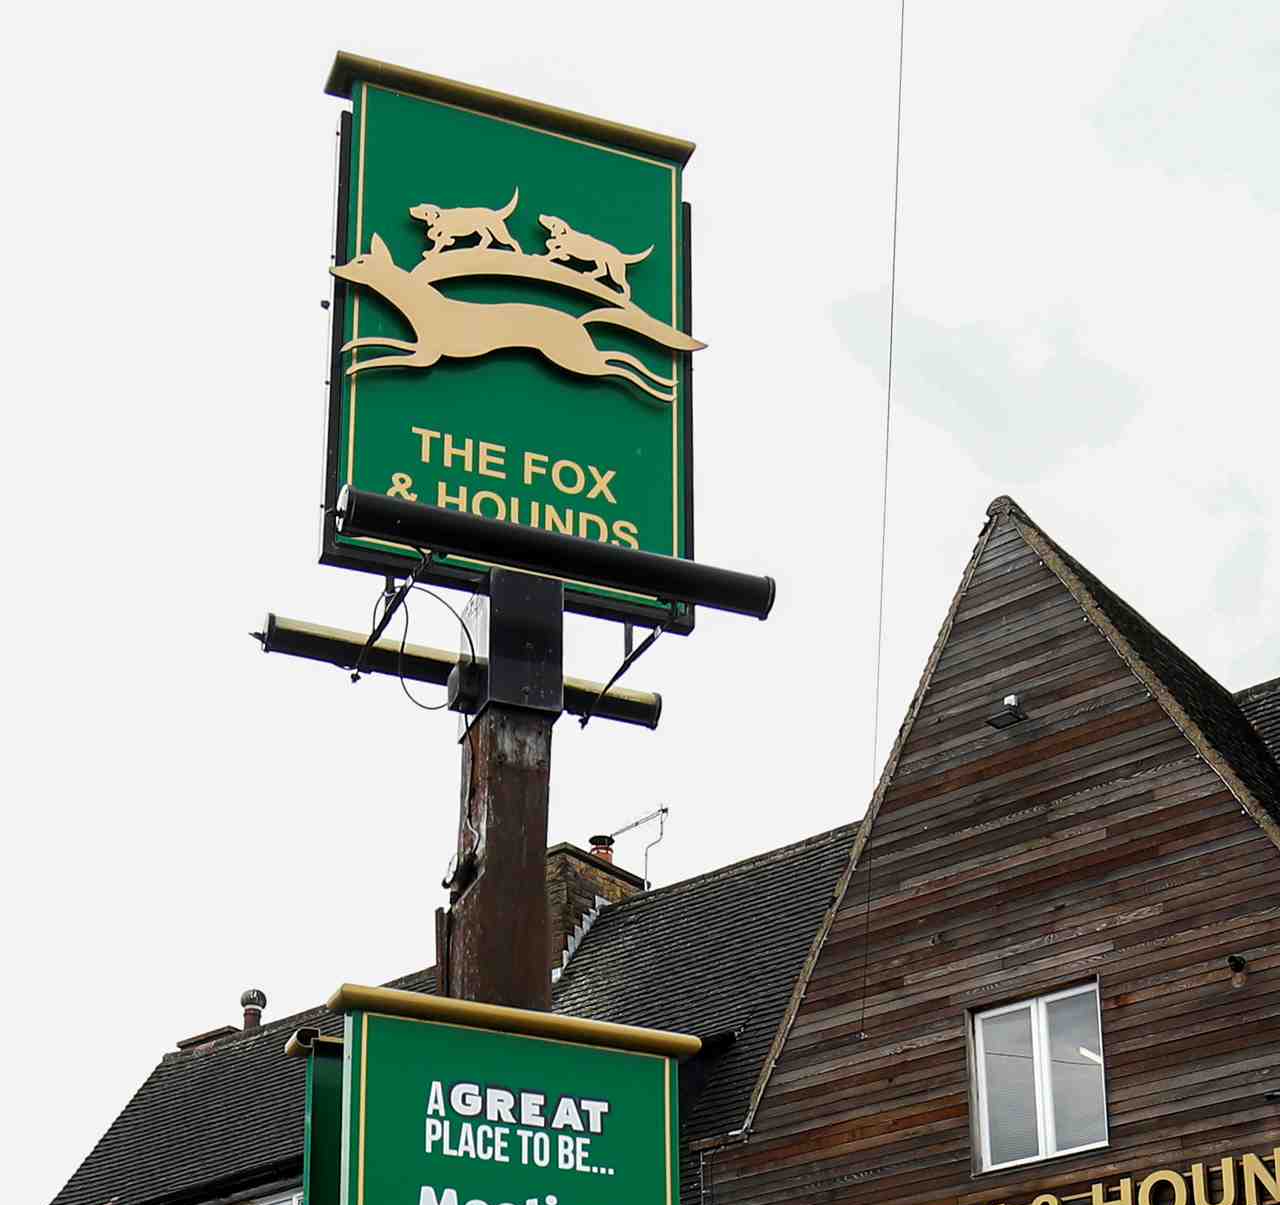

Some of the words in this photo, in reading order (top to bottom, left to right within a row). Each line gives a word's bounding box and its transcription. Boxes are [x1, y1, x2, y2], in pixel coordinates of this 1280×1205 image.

[411, 426, 507, 480] THE
[523, 450, 618, 504] FOX
[386, 472, 418, 502] &
[437, 481, 640, 550] HOUNDS
[427, 1080, 446, 1117] A
[450, 1083, 610, 1134] GREAT
[425, 1117, 510, 1163] PLACE
[516, 1129, 551, 1168] TO
[557, 1134, 615, 1176] BE...
